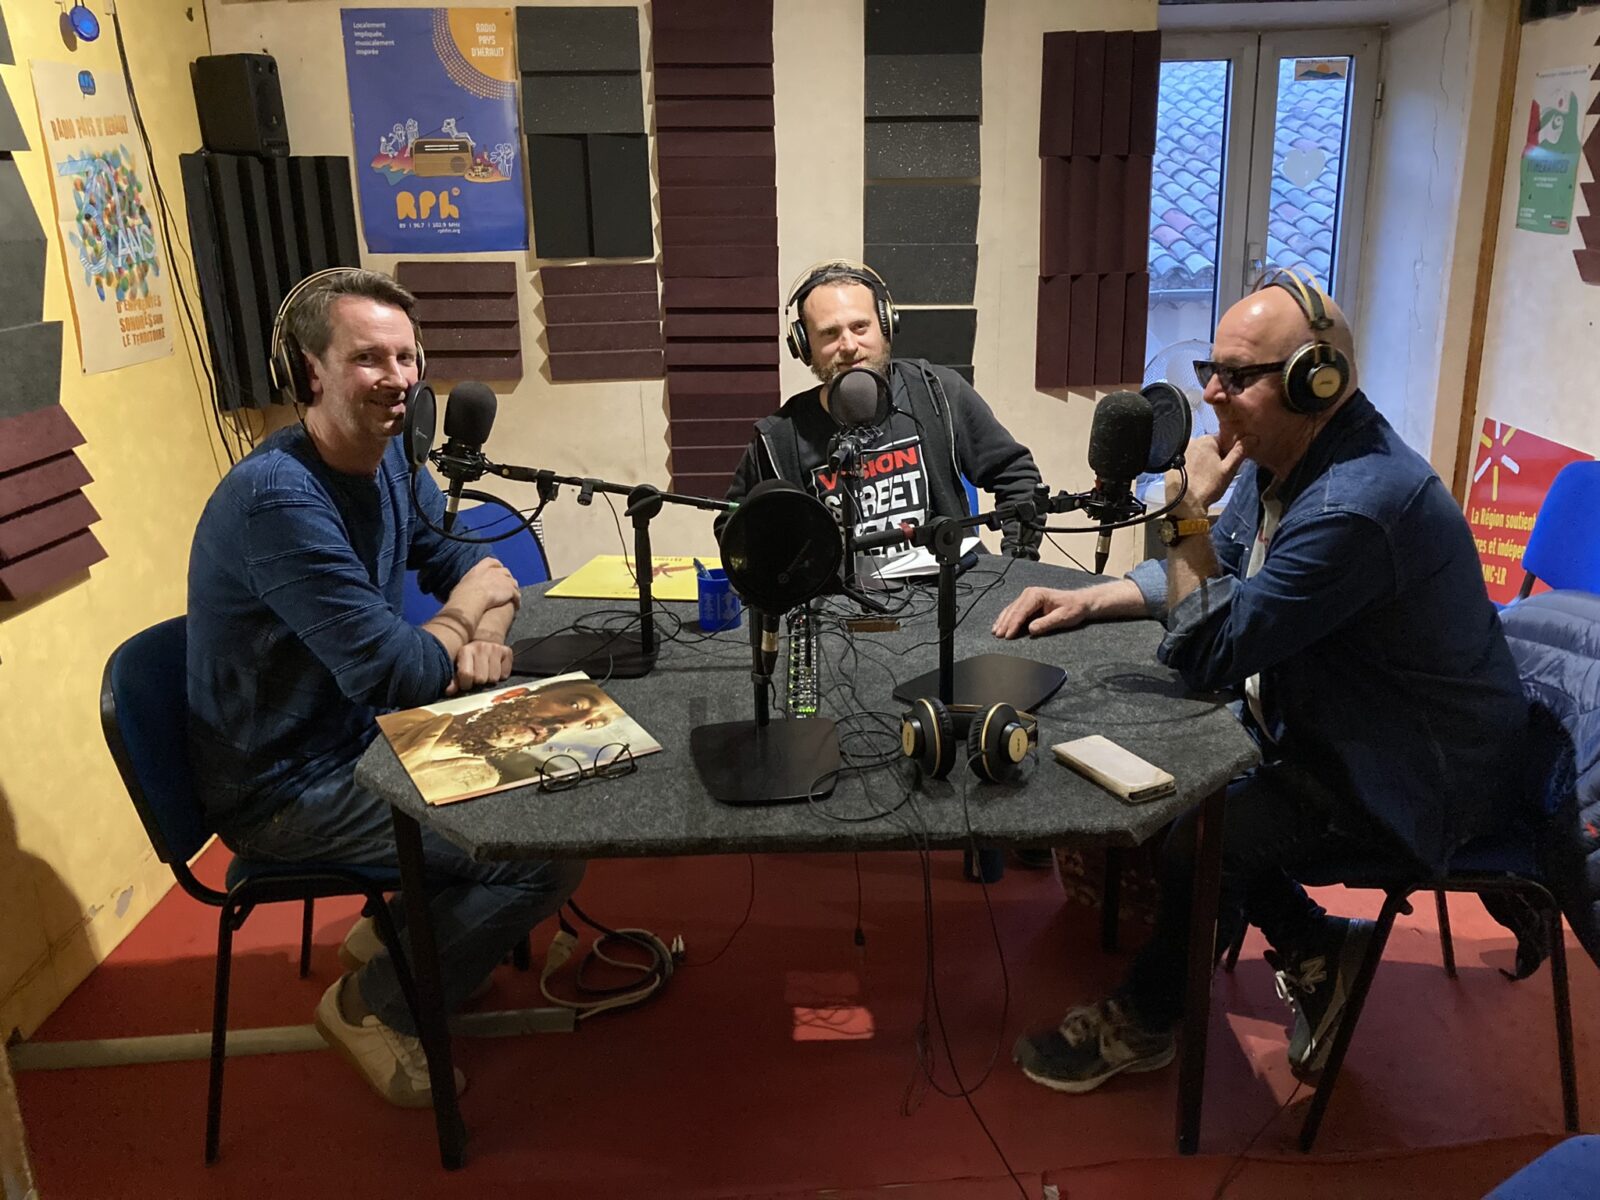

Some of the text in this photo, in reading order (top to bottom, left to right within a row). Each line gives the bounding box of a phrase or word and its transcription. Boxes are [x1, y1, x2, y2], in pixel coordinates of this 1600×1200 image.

[475, 23, 497, 33] RADIO
[478, 35, 496, 45] PAYS
[825, 470, 921, 522] SREET
[1471, 507, 1480, 525] La
[1480, 507, 1504, 530] Région
[1488, 537, 1496, 555] et
